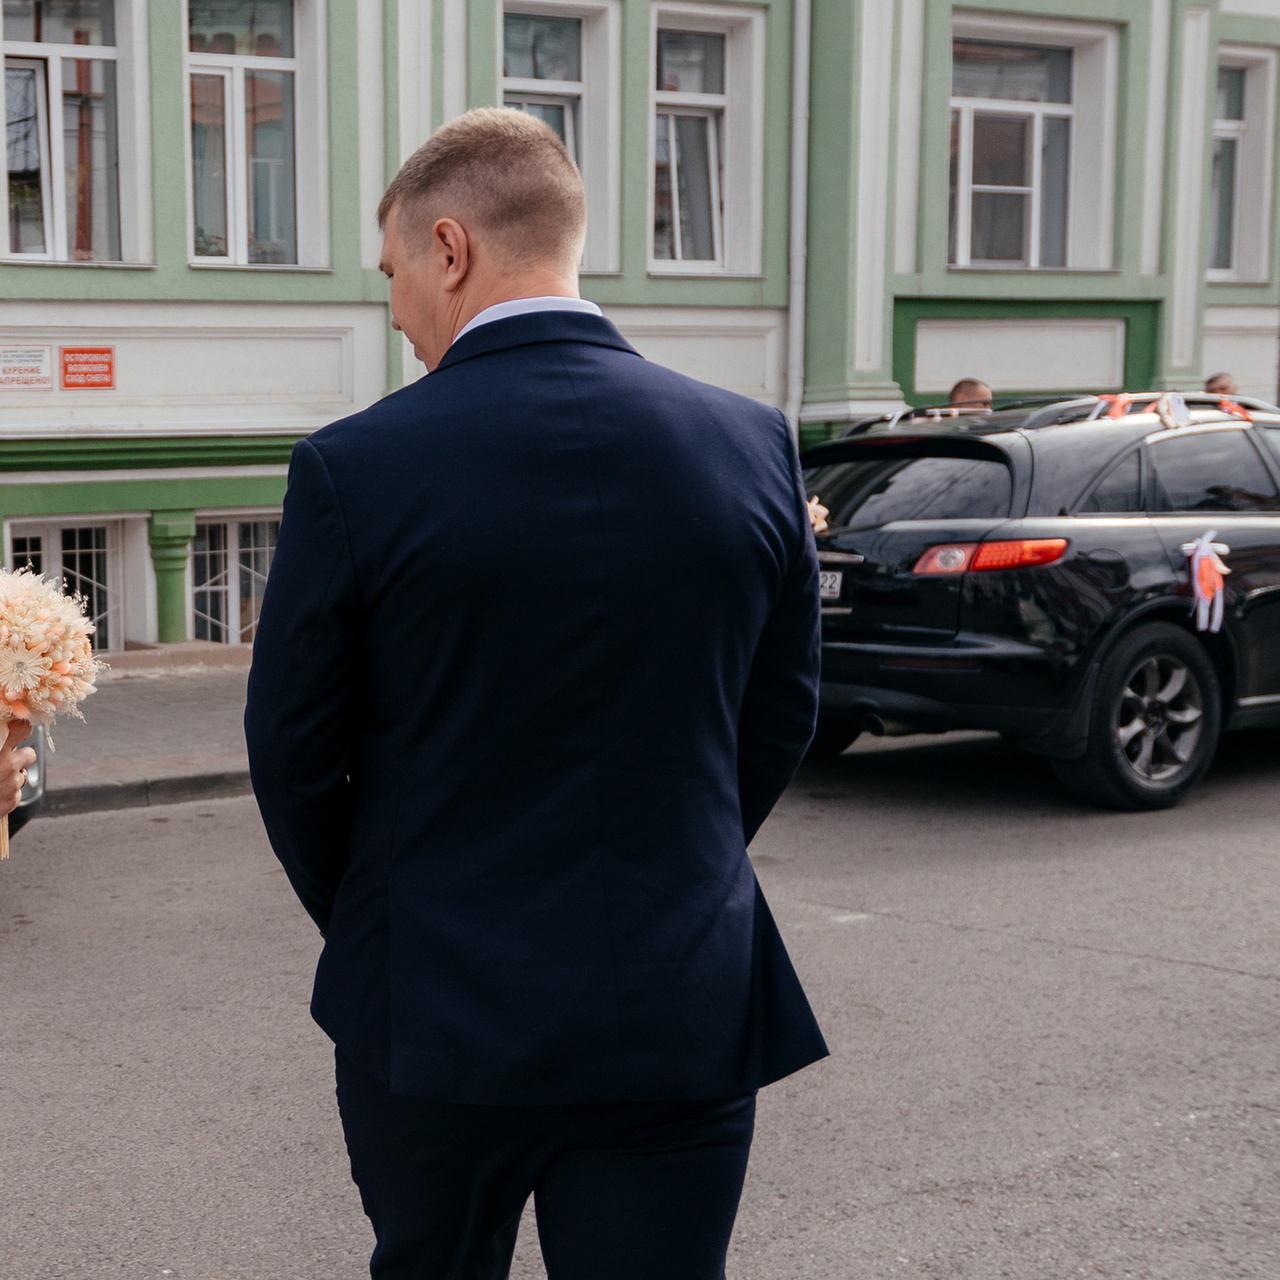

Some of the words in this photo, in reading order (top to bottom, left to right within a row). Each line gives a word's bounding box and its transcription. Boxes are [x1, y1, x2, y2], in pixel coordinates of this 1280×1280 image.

[64, 353, 112, 362] ОСТОРОЖНО!
[2, 365, 41, 374] КУРЕНИЕ
[67, 363, 109, 372] ВОЗМОЖЕН
[65, 373, 86, 384] СХОД
